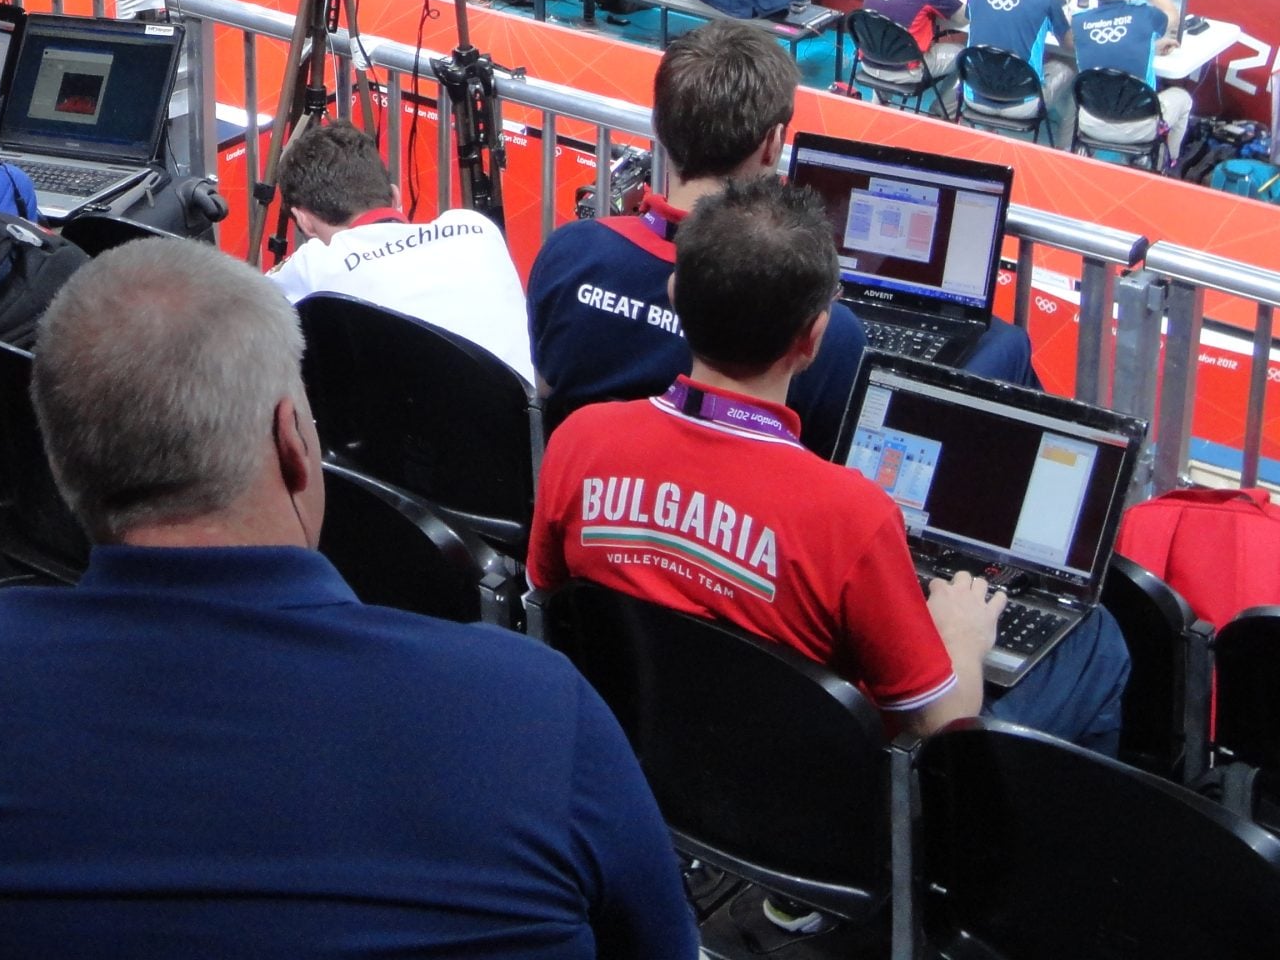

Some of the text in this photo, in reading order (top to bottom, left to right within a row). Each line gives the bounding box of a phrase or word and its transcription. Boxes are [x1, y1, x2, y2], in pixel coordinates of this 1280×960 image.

[1083, 15, 1132, 30] London 2012
[427, 110, 439, 120] 201
[226, 147, 246, 161] London
[577, 155, 597, 168] Londo
[864, 289, 894, 301] ADVENT
[577, 283, 684, 337] GREAT BRI
[1216, 356, 1238, 369] 2012
[727, 407, 782, 431] London 2012
[582, 477, 777, 577] BULGARIA
[607, 553, 734, 599] VOLLEYBALL TEAM
